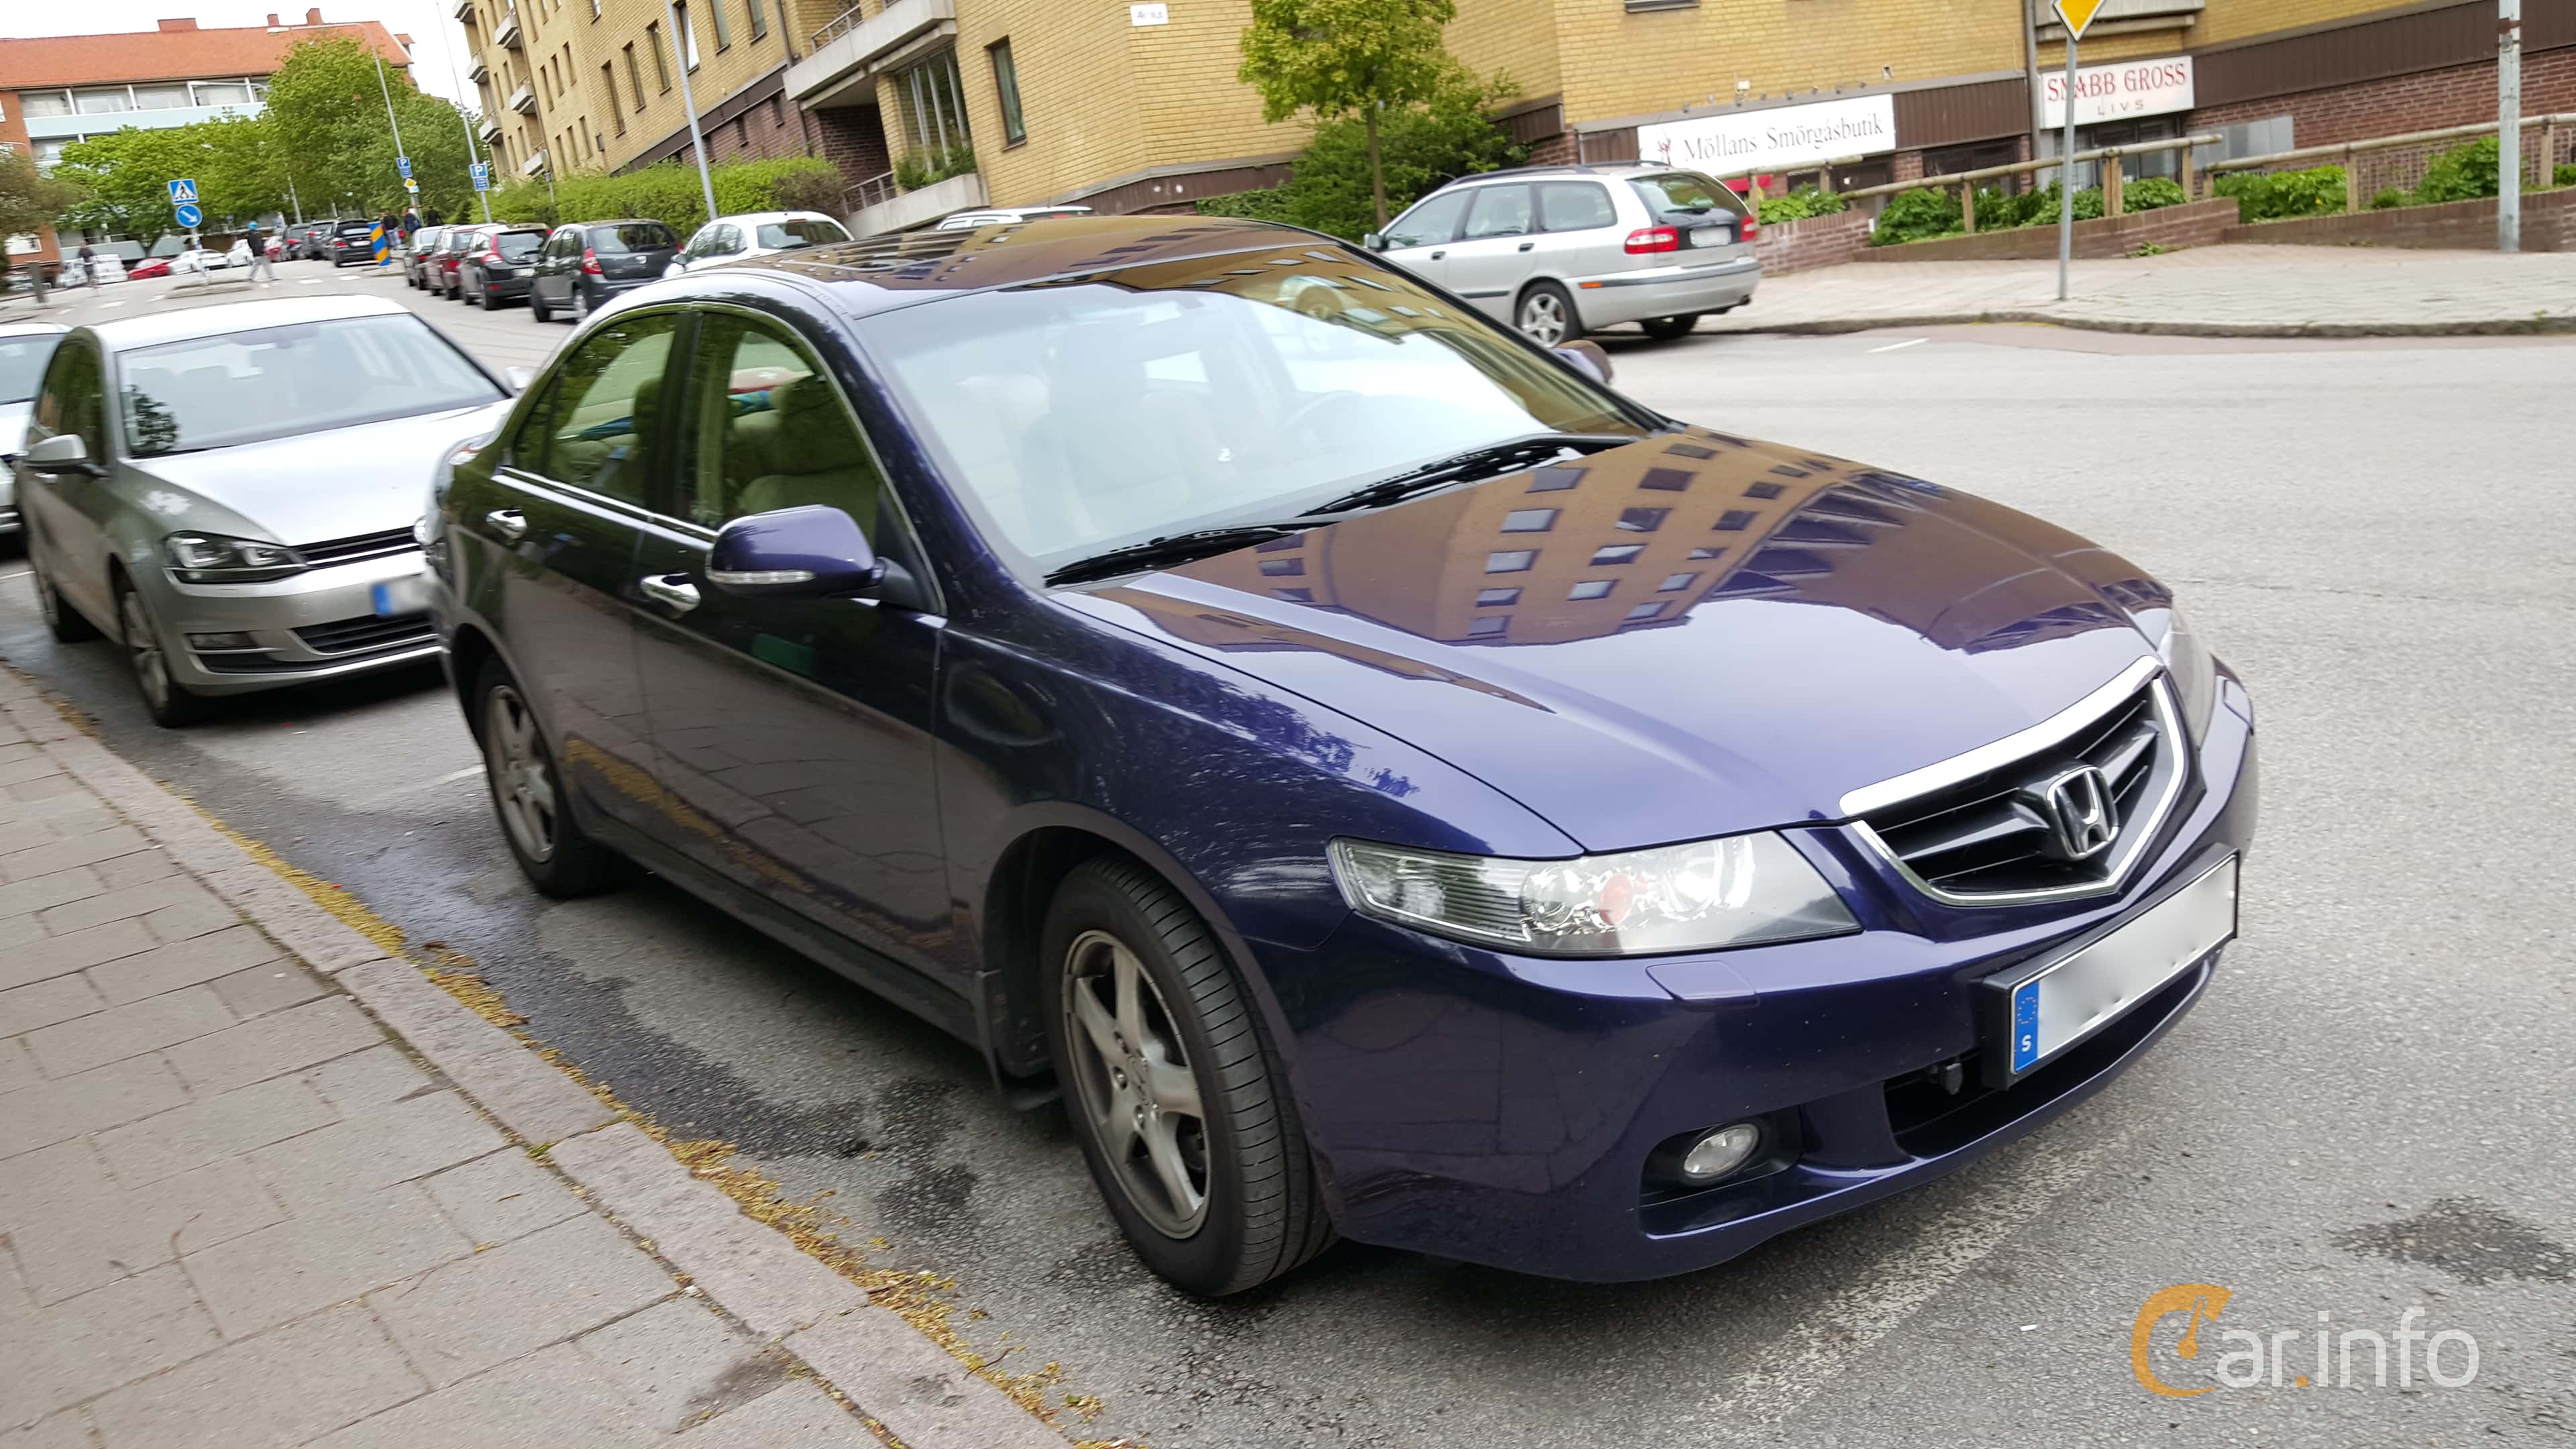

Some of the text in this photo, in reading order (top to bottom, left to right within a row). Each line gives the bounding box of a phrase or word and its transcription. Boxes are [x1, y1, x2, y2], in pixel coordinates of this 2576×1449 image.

[2124, 63, 2186, 92] GROSS
[2097, 99, 2144, 115] LIVS
[1684, 112, 1884, 162] Möllans Smörgåsbutik
[474, 166, 484, 176] P
[2022, 1034, 2031, 1052] S
